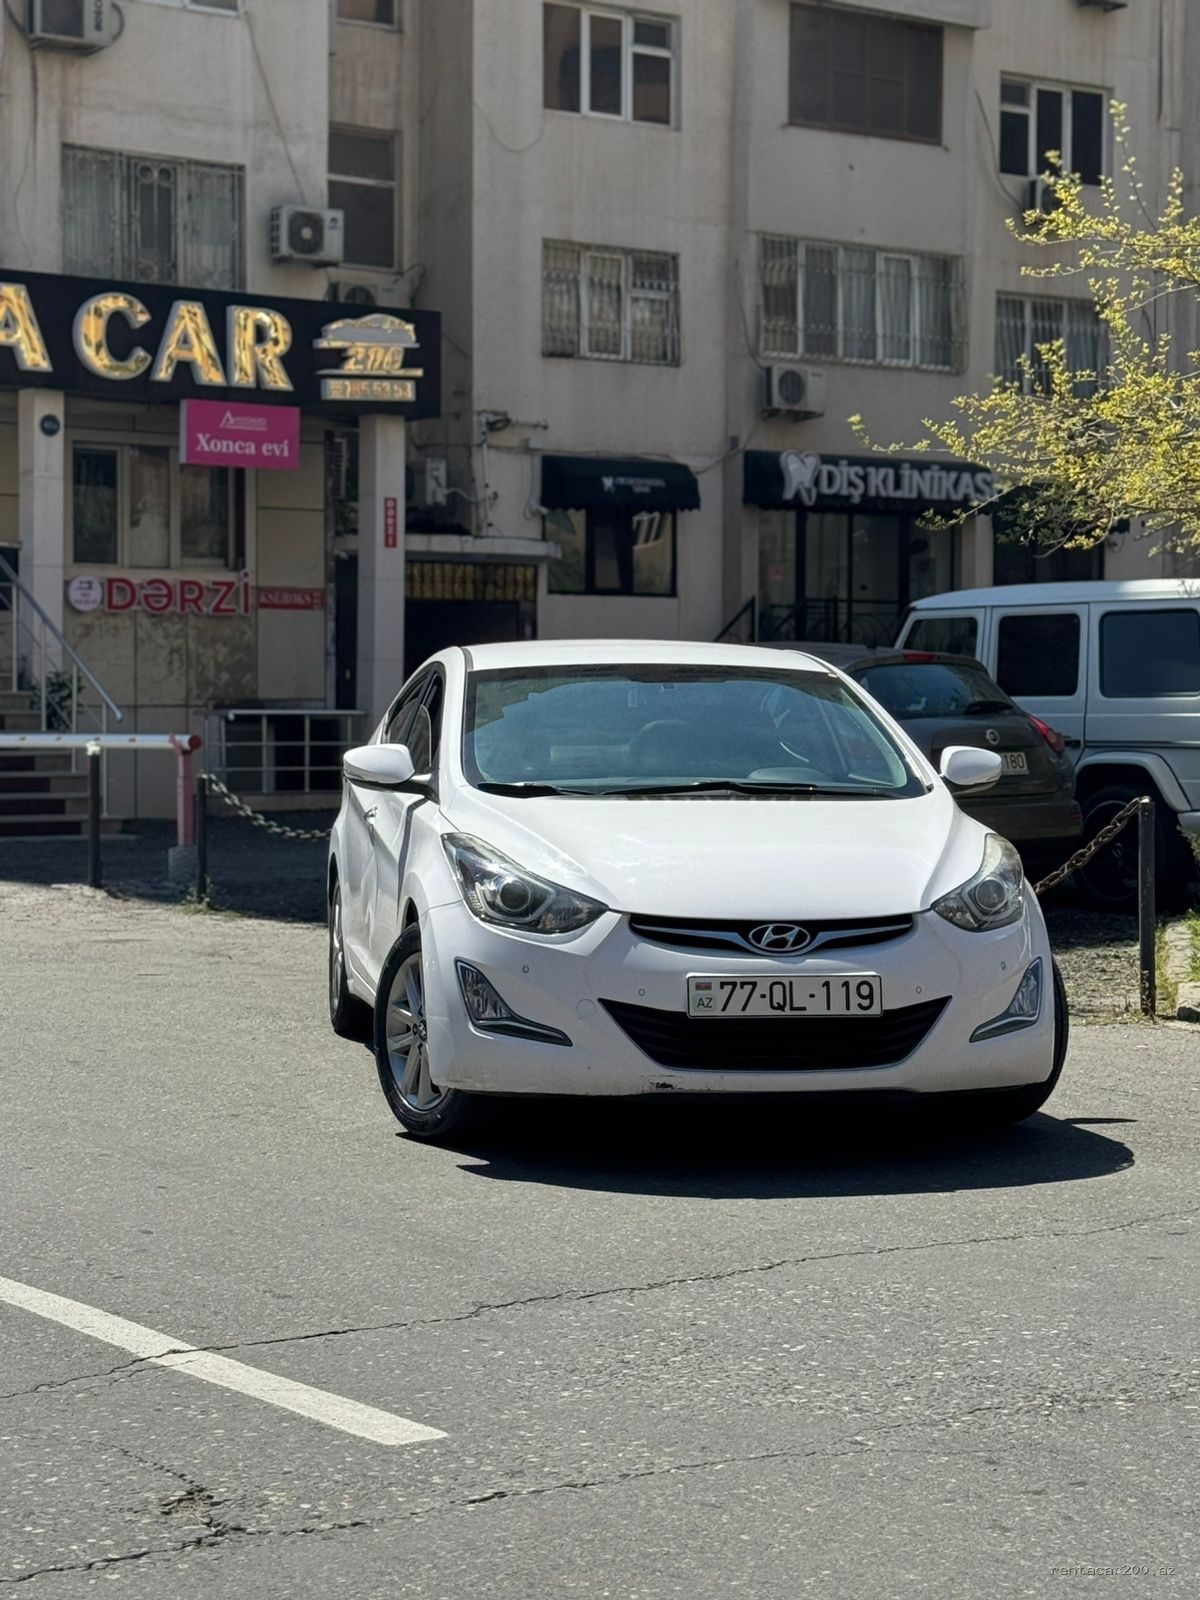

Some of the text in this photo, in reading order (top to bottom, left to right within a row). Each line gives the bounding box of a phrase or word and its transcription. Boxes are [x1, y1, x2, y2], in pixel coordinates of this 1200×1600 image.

[0, 282, 294, 391] A CAR
[196, 432, 289, 457] Xonca evi
[105, 571, 250, 614] DƏRZİ
[1004, 754, 1025, 769] 180
[696, 980, 874, 1012] AZ 77-QL-119
